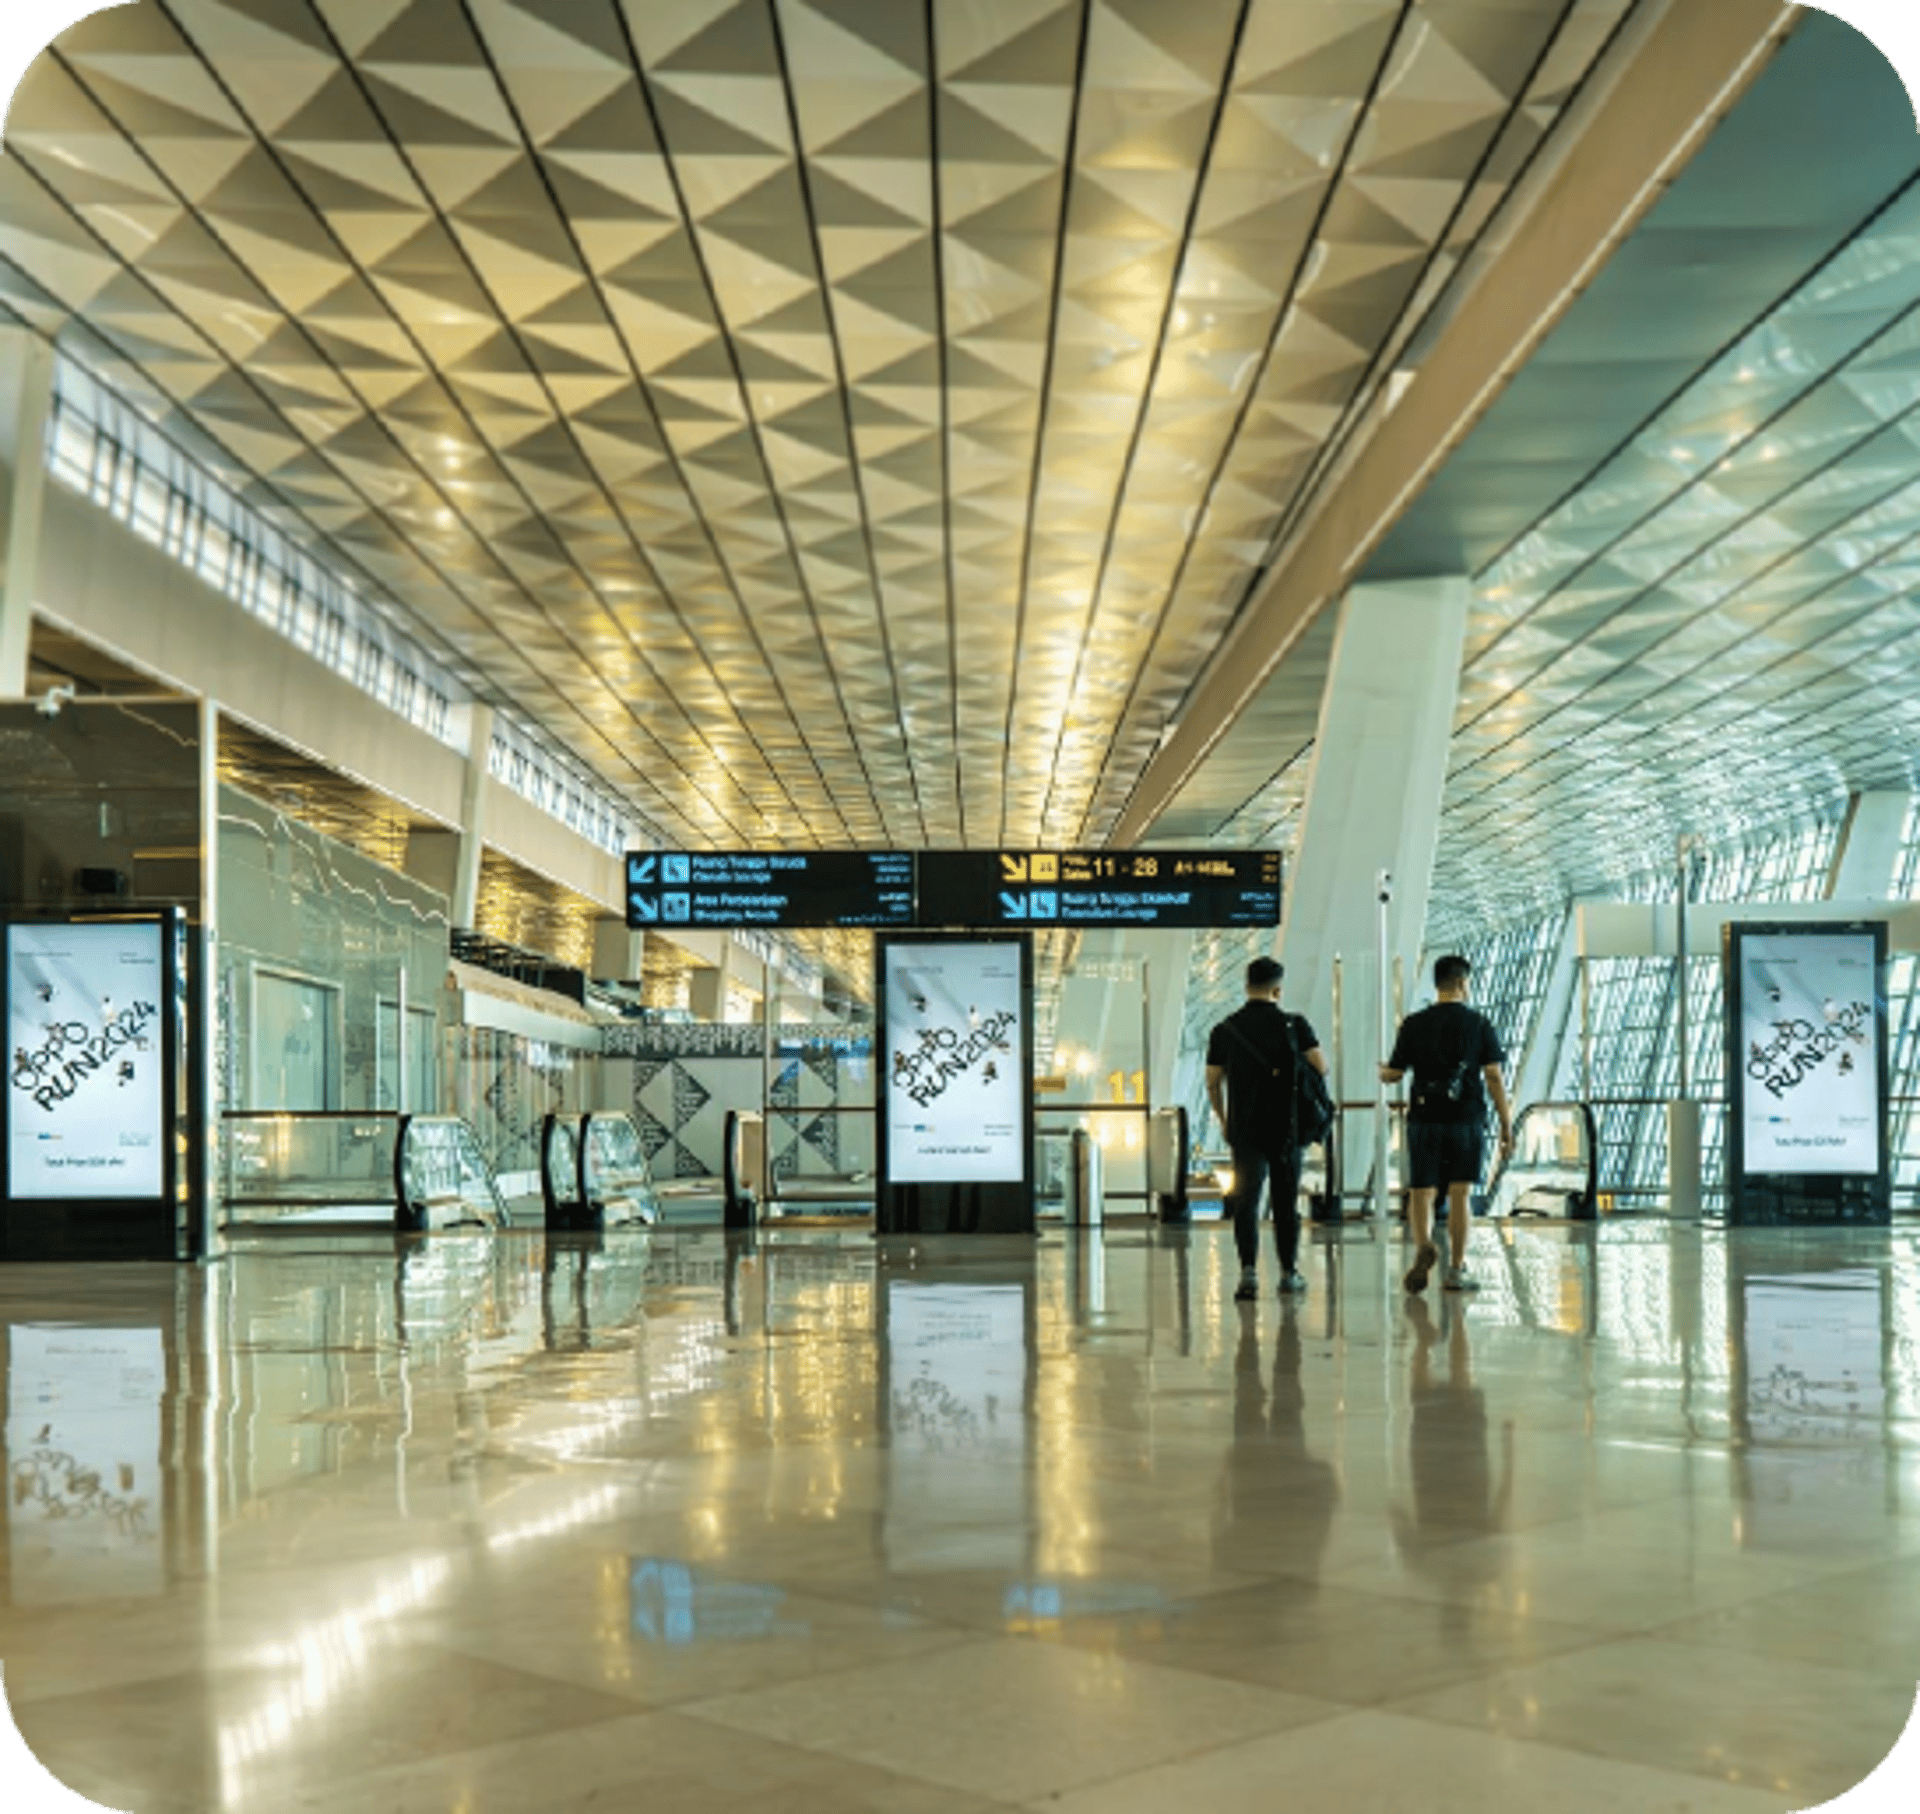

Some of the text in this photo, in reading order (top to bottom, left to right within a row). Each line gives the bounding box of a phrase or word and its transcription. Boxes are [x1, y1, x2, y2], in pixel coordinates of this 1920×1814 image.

[1093, 857, 1114, 876] 11
[1132, 857, 1158, 876] 28
[1108, 1071, 1144, 1103] 11
